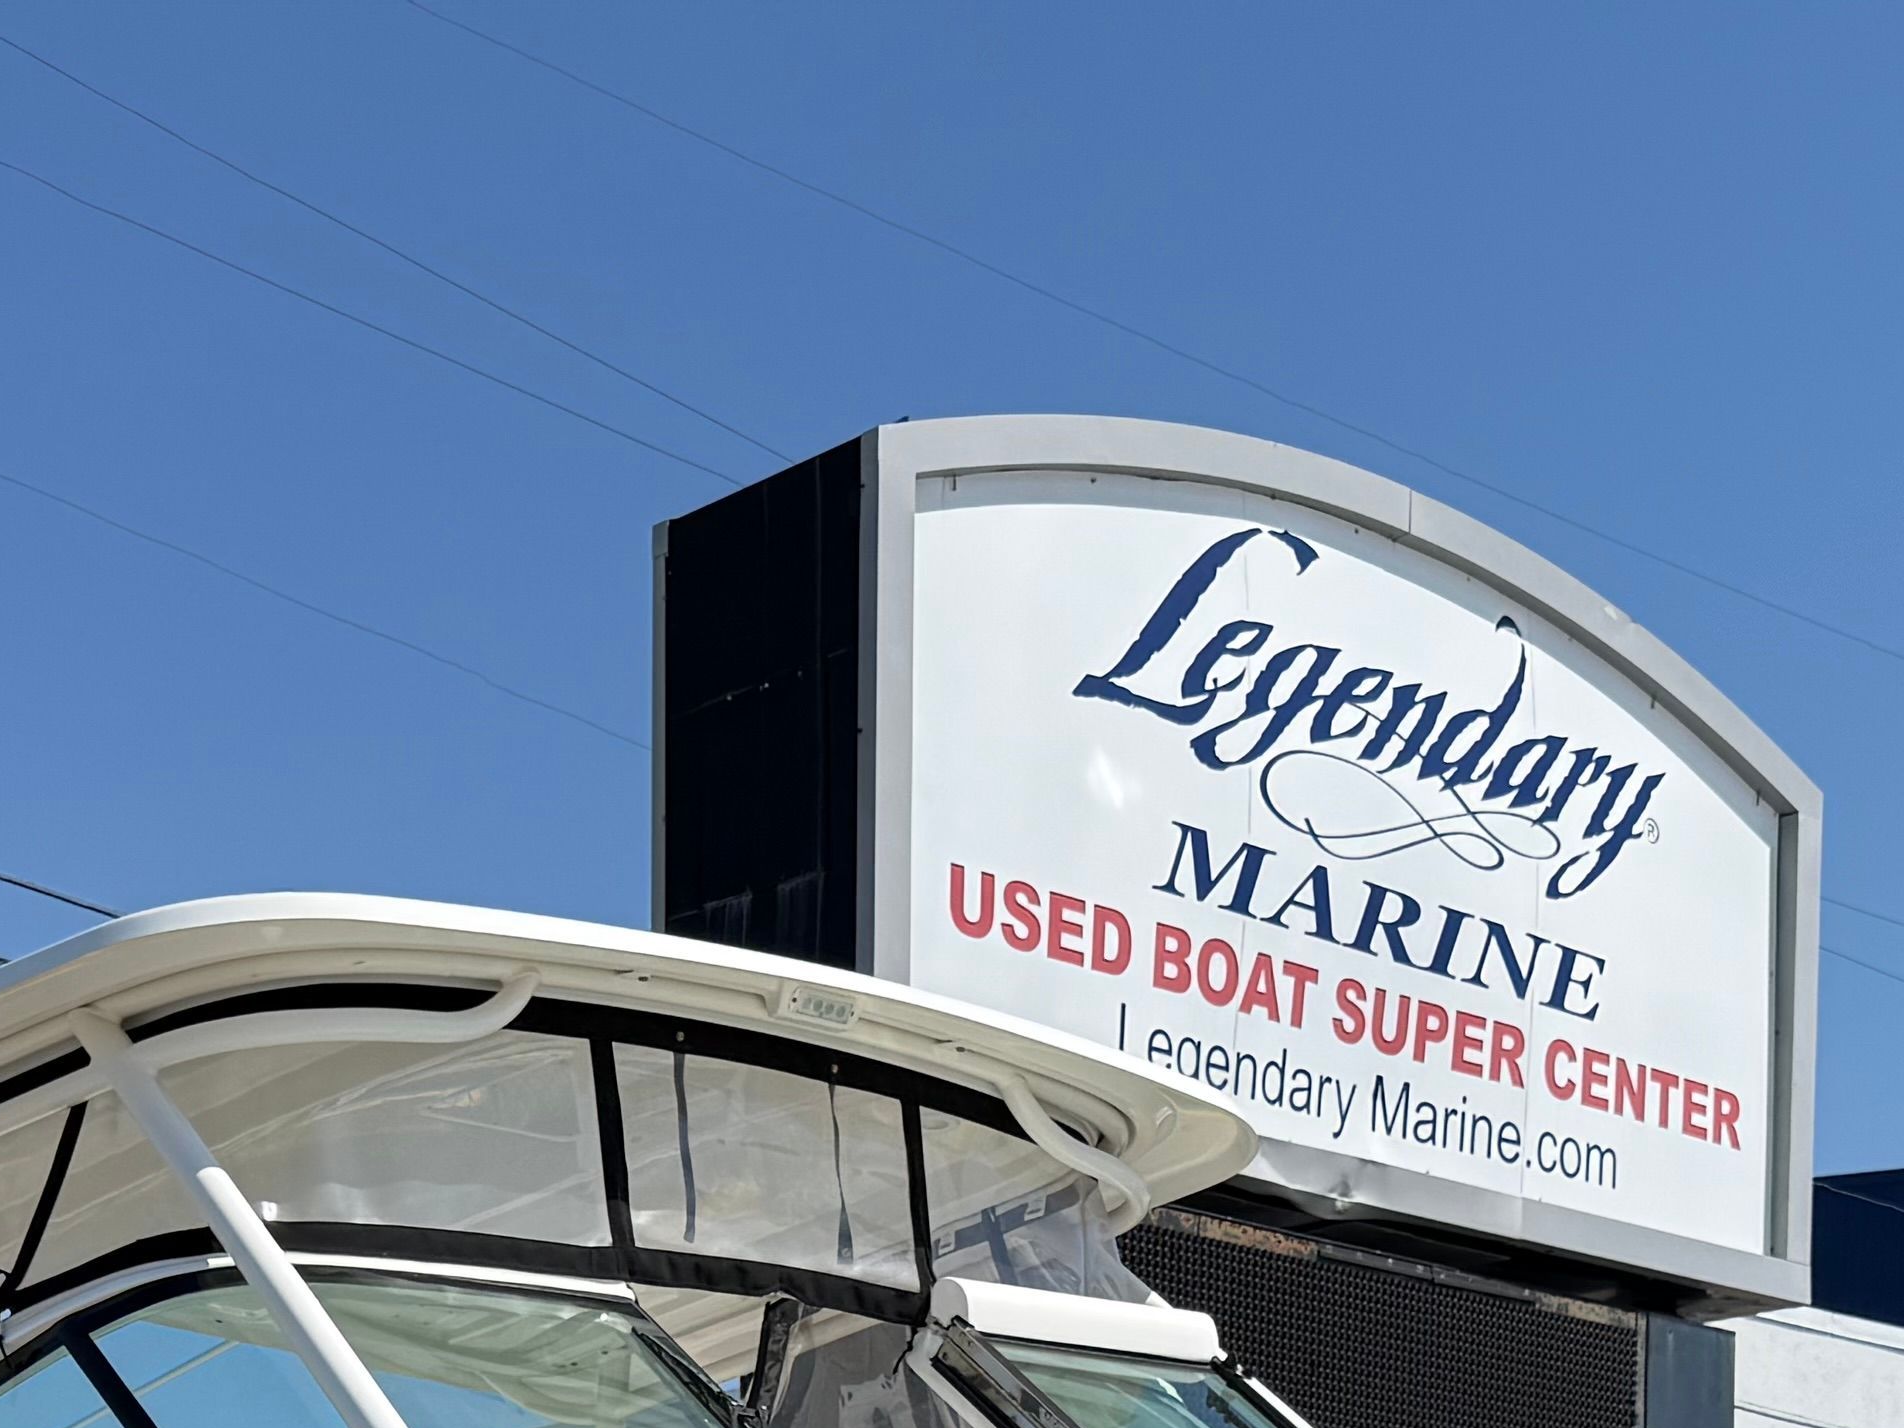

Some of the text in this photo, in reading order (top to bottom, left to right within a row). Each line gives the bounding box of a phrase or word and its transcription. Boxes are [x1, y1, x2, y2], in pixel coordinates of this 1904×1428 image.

[1072, 527, 1665, 899] Legendary
[949, 862, 1741, 1150] USED BOAT SUPER CENTER
[1151, 821, 1606, 1020] MARINE
[1371, 1074, 1618, 1188] Marine.com
